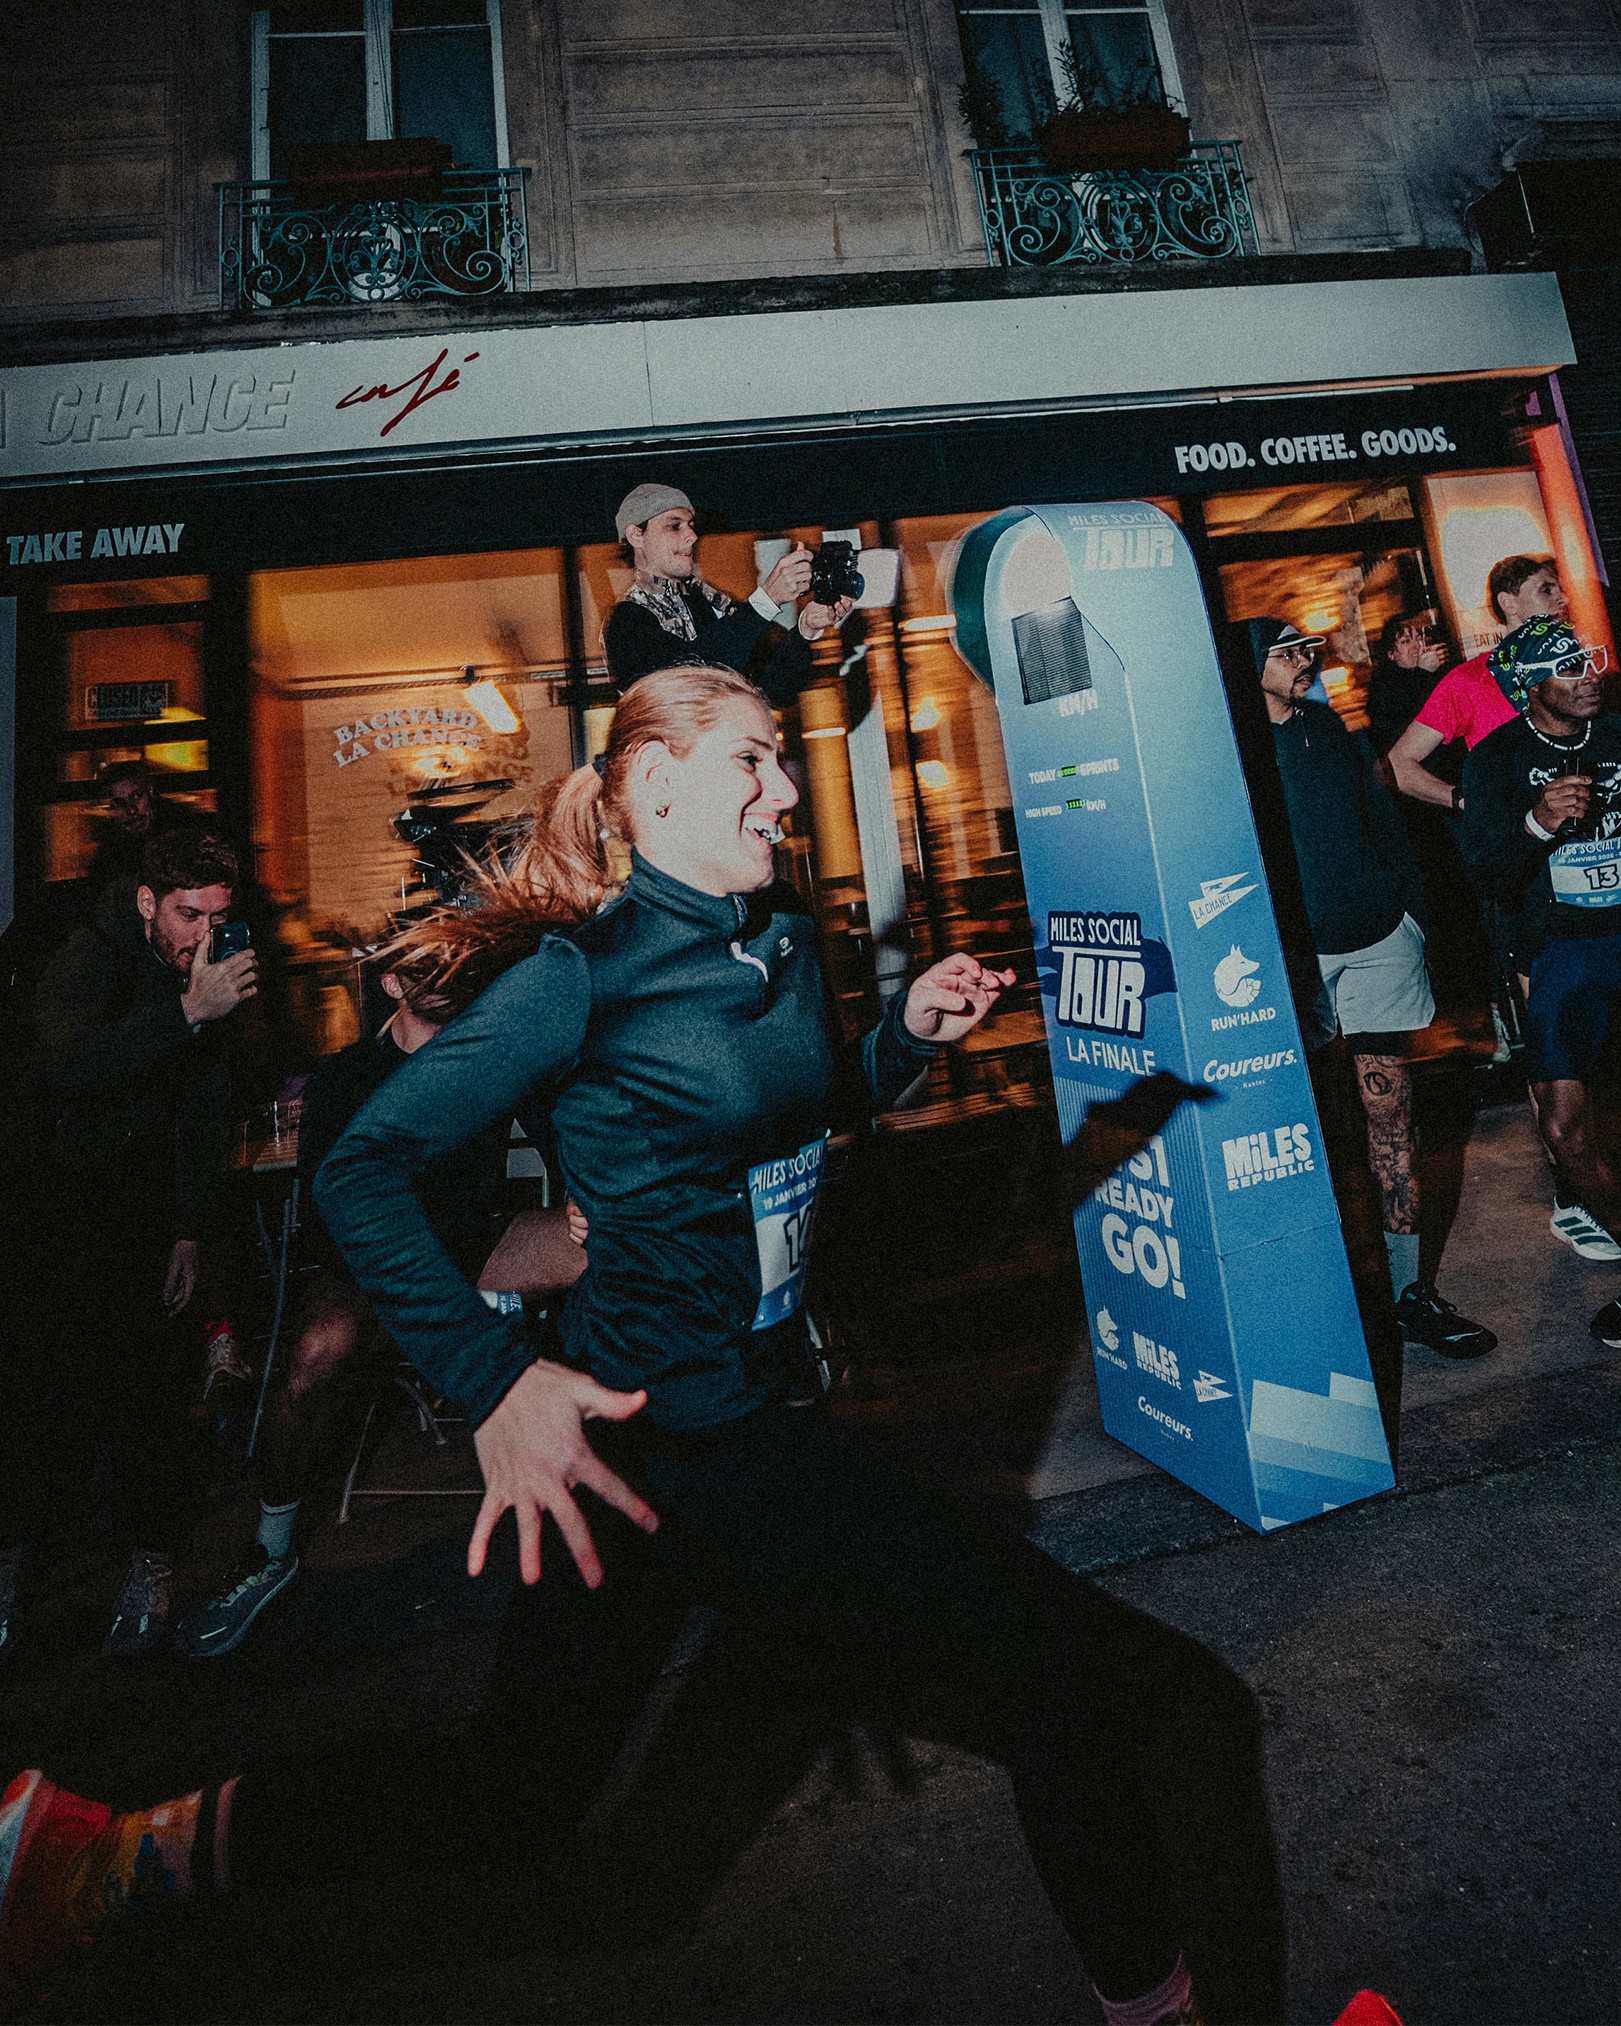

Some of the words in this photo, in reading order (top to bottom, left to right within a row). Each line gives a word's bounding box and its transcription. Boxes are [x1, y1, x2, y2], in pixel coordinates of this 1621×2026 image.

[38, 370, 296, 446] CHANCE
[1174, 442, 1256, 473] FOOD.
[1260, 433, 1357, 466] COFFEE.
[1361, 426, 1457, 458] GOODS.
[1068, 514, 1108, 526] MILES
[1111, 512, 1166, 524] SOCIAL
[7, 531, 82, 566] TAKE
[91, 523, 185, 559] AWAY
[1073, 523, 1174, 571] TOUR
[1474, 633, 1490, 647] EAT
[334, 707, 477, 745] BACKYARD
[332, 741, 370, 767] LA
[374, 728, 482, 751] CHANCE
[1028, 768, 1056, 784] TODAY
[1080, 758, 1120, 776] SPRINTS
[1580, 840, 1614, 854] SOCIAL
[1584, 863, 1619, 890] 13
[1193, 906, 1205, 920] LA
[1204, 893, 1233, 914] CHANCE
[1050, 916, 1085, 943] MILES
[1088, 918, 1141, 946] SOCIAL
[1052, 945, 1146, 1032] TOUR
[1211, 1007, 1276, 1031] RUN'HARD
[1066, 1036, 1092, 1065] LA
[1094, 1040, 1157, 1077] FINALE
[1203, 1049, 1297, 1082] Coureurs.
[752, 1161, 787, 1194] MILES
[1227, 1159, 1315, 1192] REPUBLIC
[775, 1181, 807, 1207] JANVIER
[1095, 1177, 1174, 1229] READY
[1102, 1212, 1186, 1300] GO!
[1136, 1359, 1182, 1391] REPUBLIC
[1138, 1395, 1194, 1442] Coureurs.
